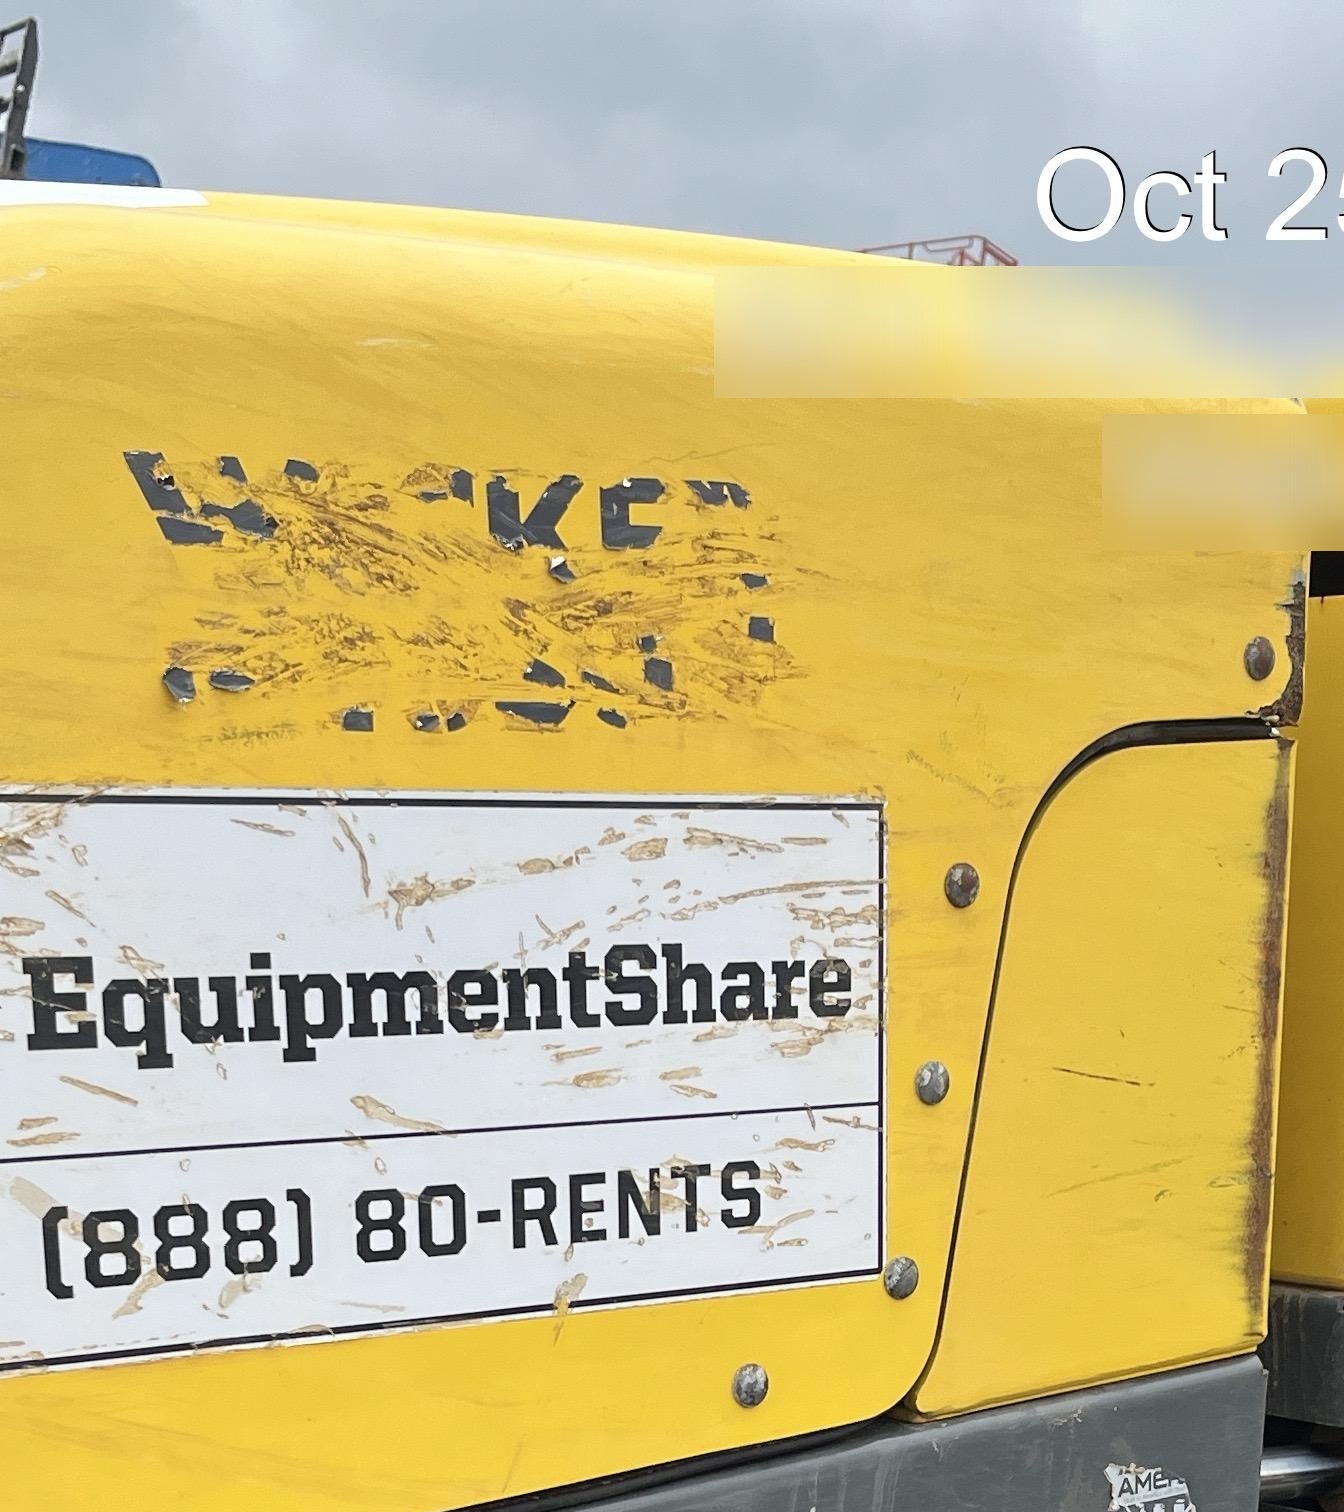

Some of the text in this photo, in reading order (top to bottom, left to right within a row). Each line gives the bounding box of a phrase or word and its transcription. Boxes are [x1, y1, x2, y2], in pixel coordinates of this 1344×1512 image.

[22, 943, 853, 1070] EquipmentShare
[42, 1160, 761, 1299] (888) 80-RENTS
